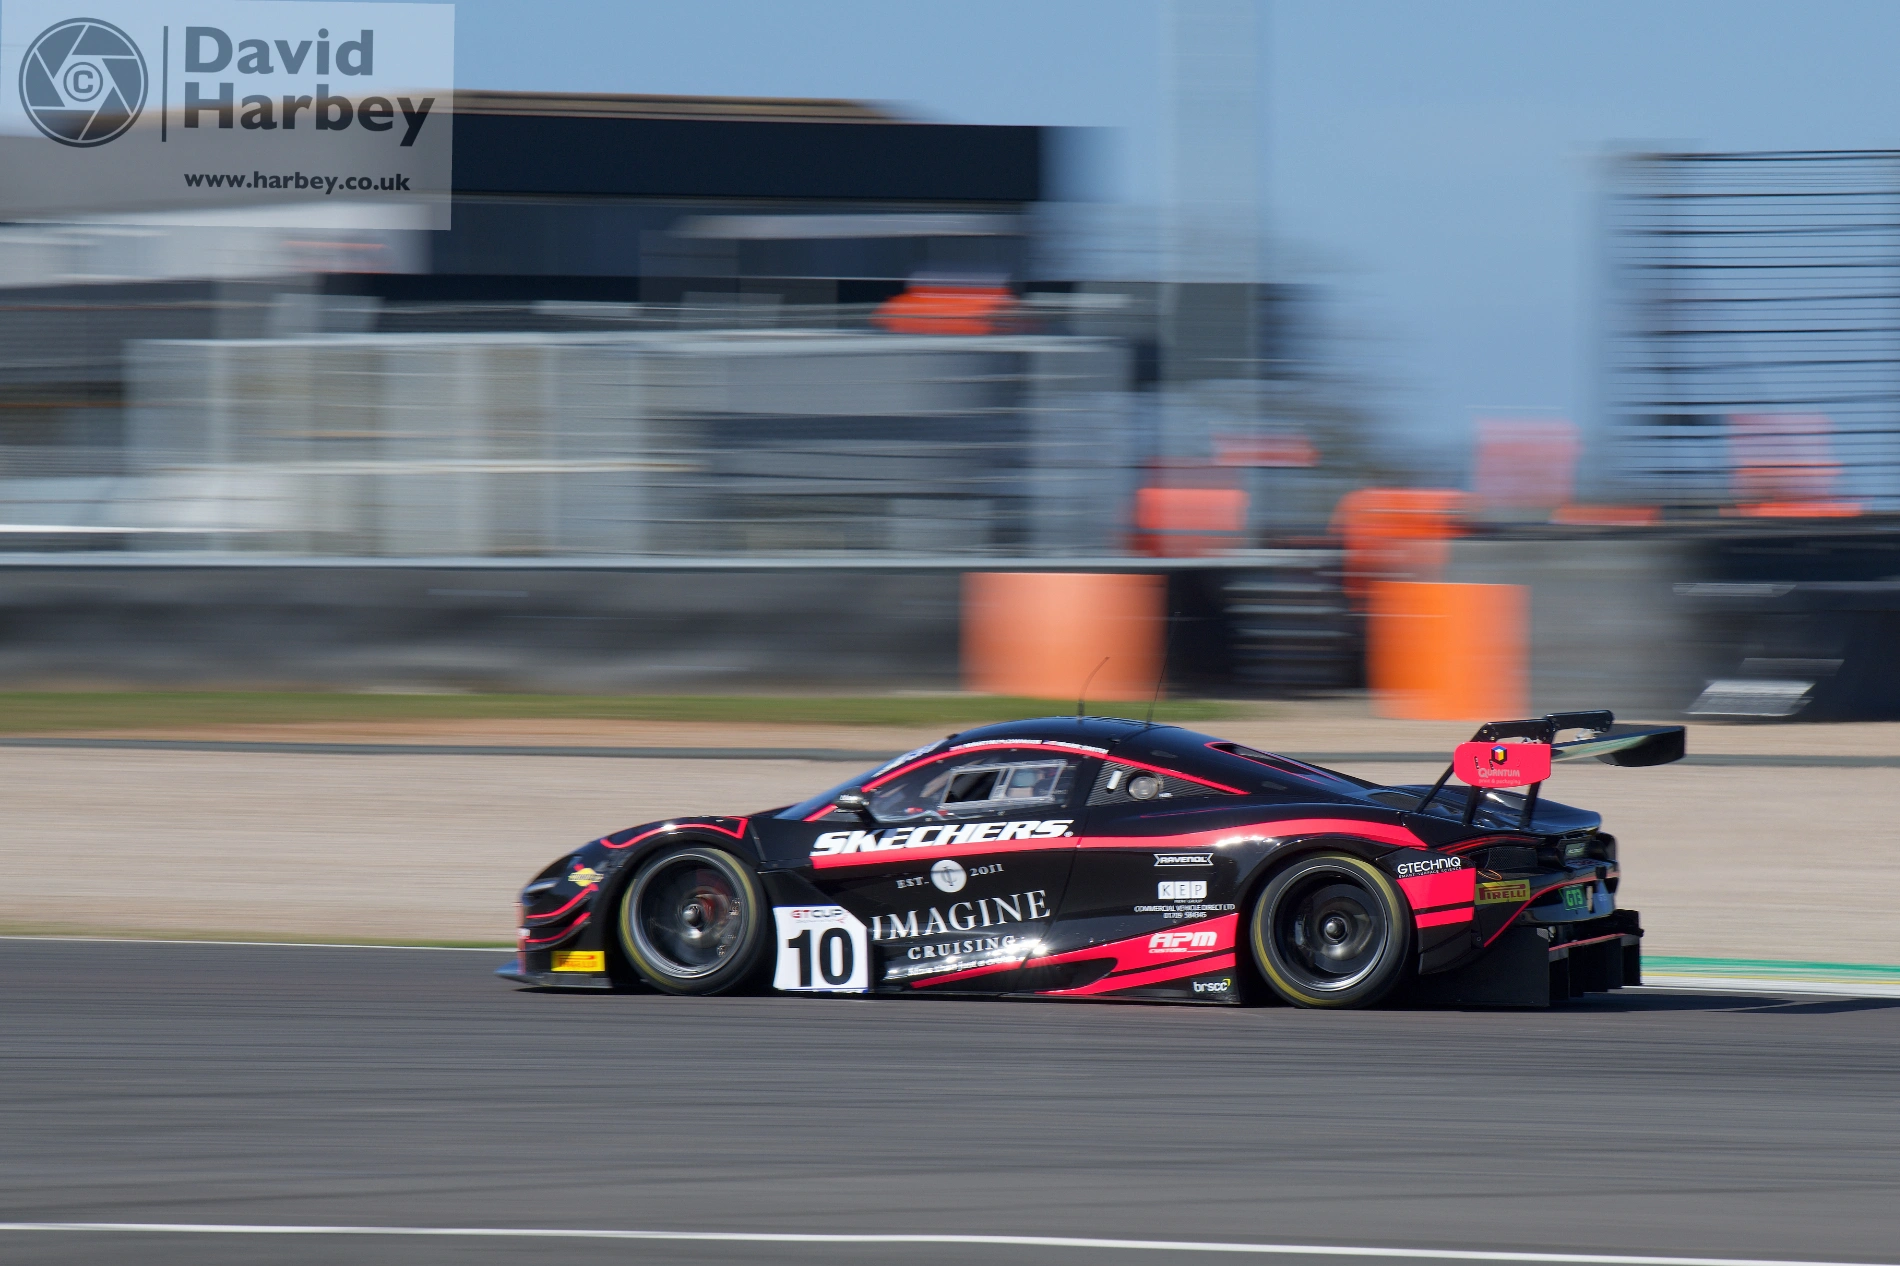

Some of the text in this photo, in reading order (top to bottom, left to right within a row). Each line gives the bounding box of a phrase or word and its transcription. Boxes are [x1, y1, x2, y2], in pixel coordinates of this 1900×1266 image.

[970, 863, 1004, 877] 2011
[1397, 856, 1461, 875] GTECHNIQ
[1478, 883, 1526, 900] PIRELLI
[1566, 888, 1583, 906] GT3
[871, 890, 1051, 940] IMAGINE
[907, 935, 1017, 960] CRUISING
[1148, 932, 1217, 948] APM
[787, 928, 853, 987] 10
[1193, 981, 1228, 992] brscc
